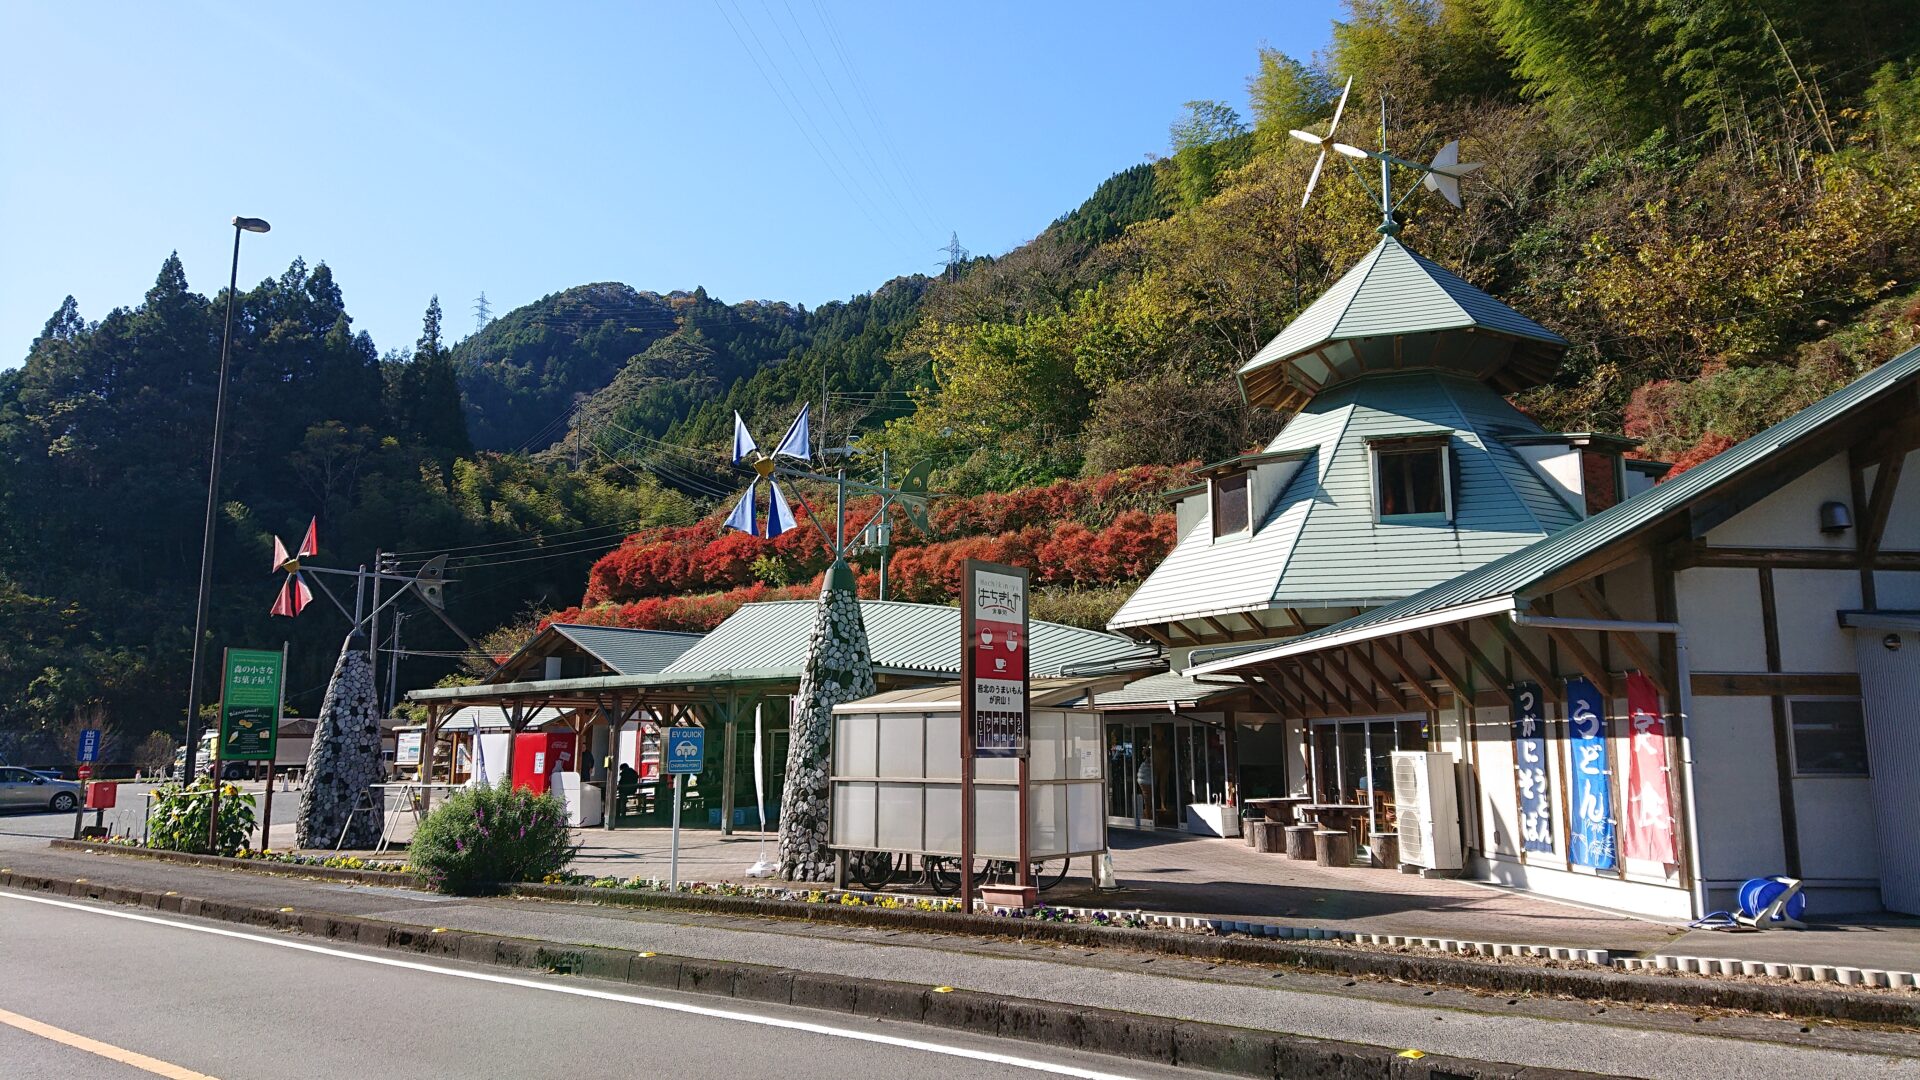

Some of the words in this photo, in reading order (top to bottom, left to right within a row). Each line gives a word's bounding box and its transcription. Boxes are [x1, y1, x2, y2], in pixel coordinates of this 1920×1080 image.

[978, 587, 1021, 612] はちきんや
[234, 665, 274, 674] 森の小さな
[82, 730, 95, 761] 出口専用
[1008, 717, 1015, 742] そば
[1519, 691, 1539, 763] つがに
[1573, 699, 1605, 823] うどん
[1519, 767, 1538, 842] そば
[1533, 767, 1552, 844] うどん
